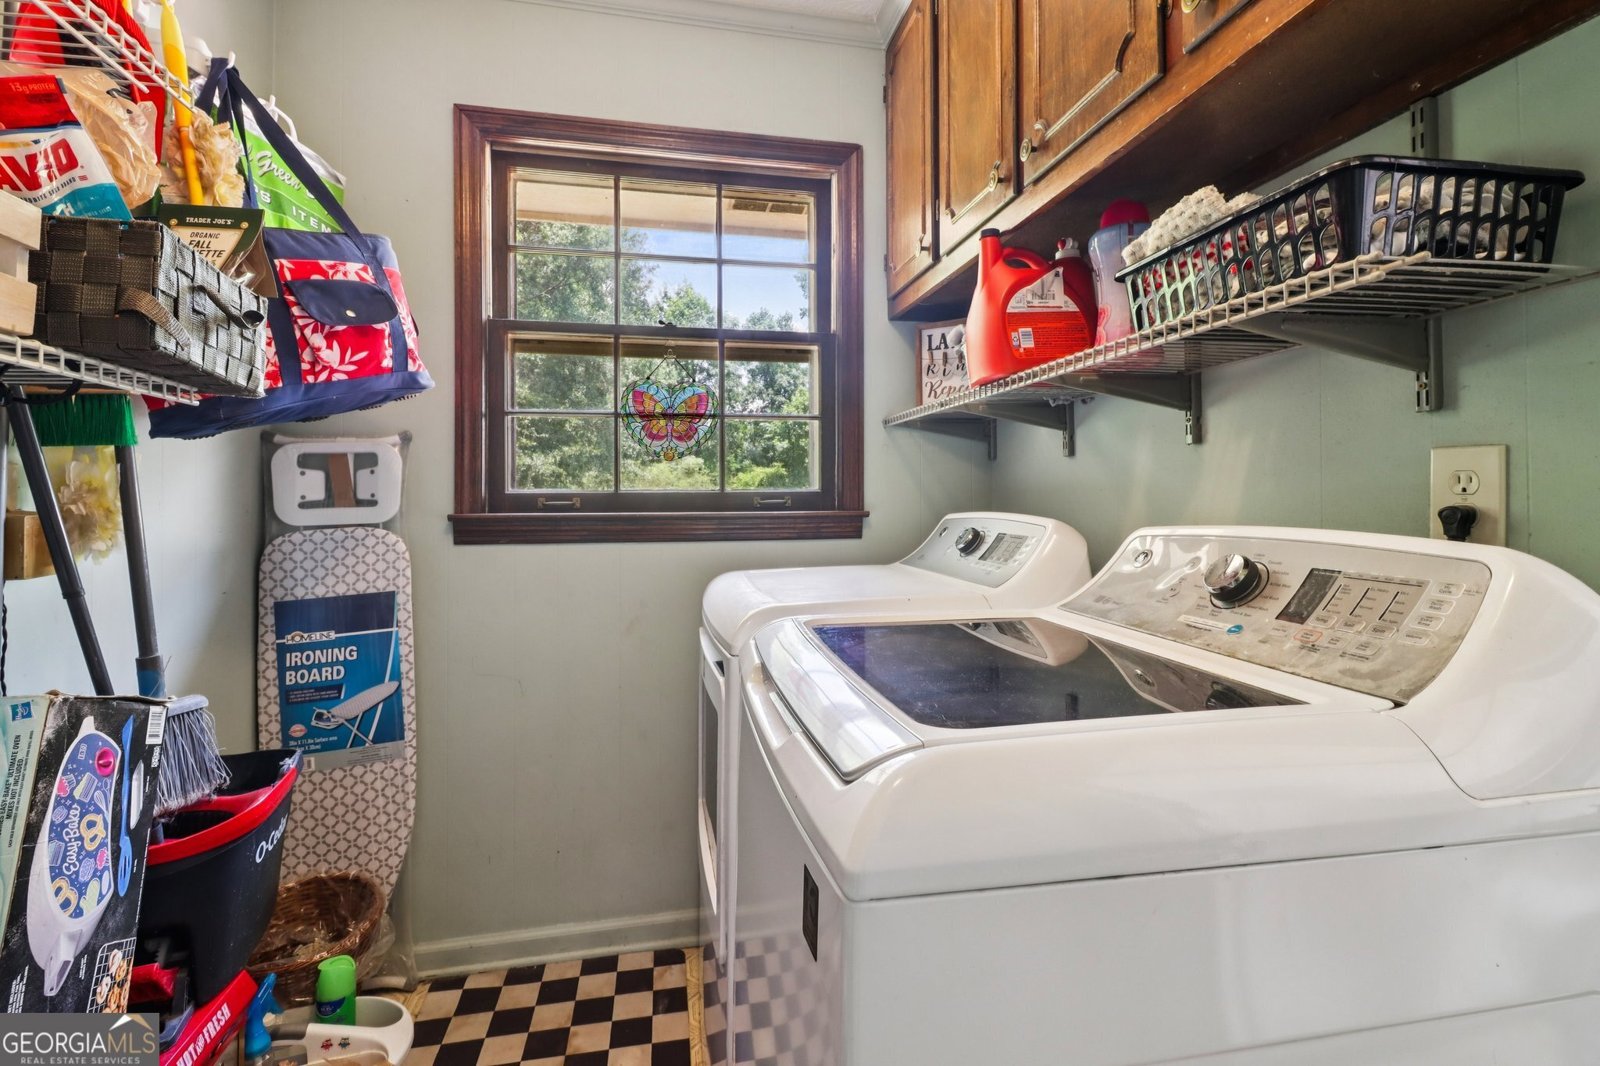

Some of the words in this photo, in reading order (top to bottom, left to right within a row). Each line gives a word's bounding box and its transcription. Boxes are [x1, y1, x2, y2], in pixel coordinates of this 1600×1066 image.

[188, 240, 211, 249] FALL
[286, 645, 358, 667] IRONING
[285, 665, 345, 685] BOARD
[8, 750, 18, 778] ULTIMATE
[13, 735, 21, 750] OVEN
[6, 802, 15, 820] MIXES
[202, 1002, 231, 1044] FRESH
